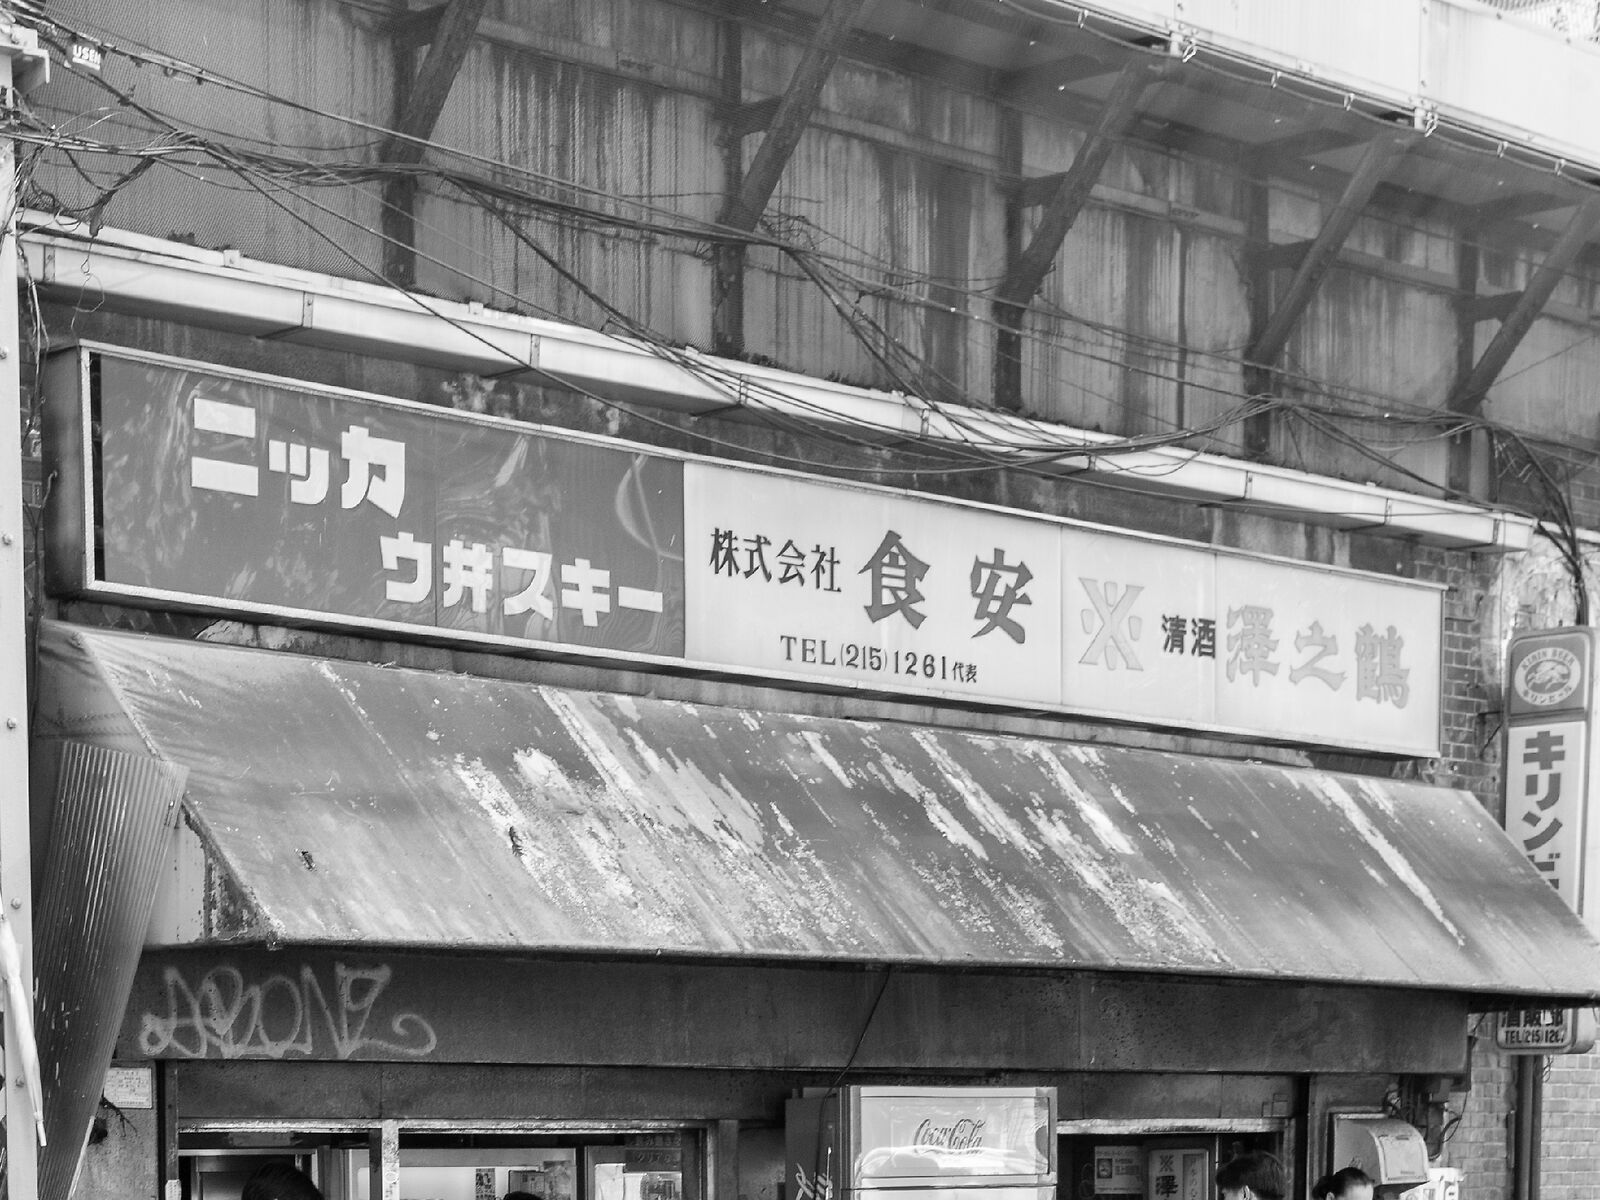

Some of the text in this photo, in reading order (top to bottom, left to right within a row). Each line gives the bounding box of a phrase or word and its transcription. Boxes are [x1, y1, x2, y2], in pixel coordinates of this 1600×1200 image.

[191, 398, 406, 519] ニッカ
[709, 527, 1034, 645] 株式会社 食安
[1161, 604, 1411, 710] 清酒 澤之鶴
